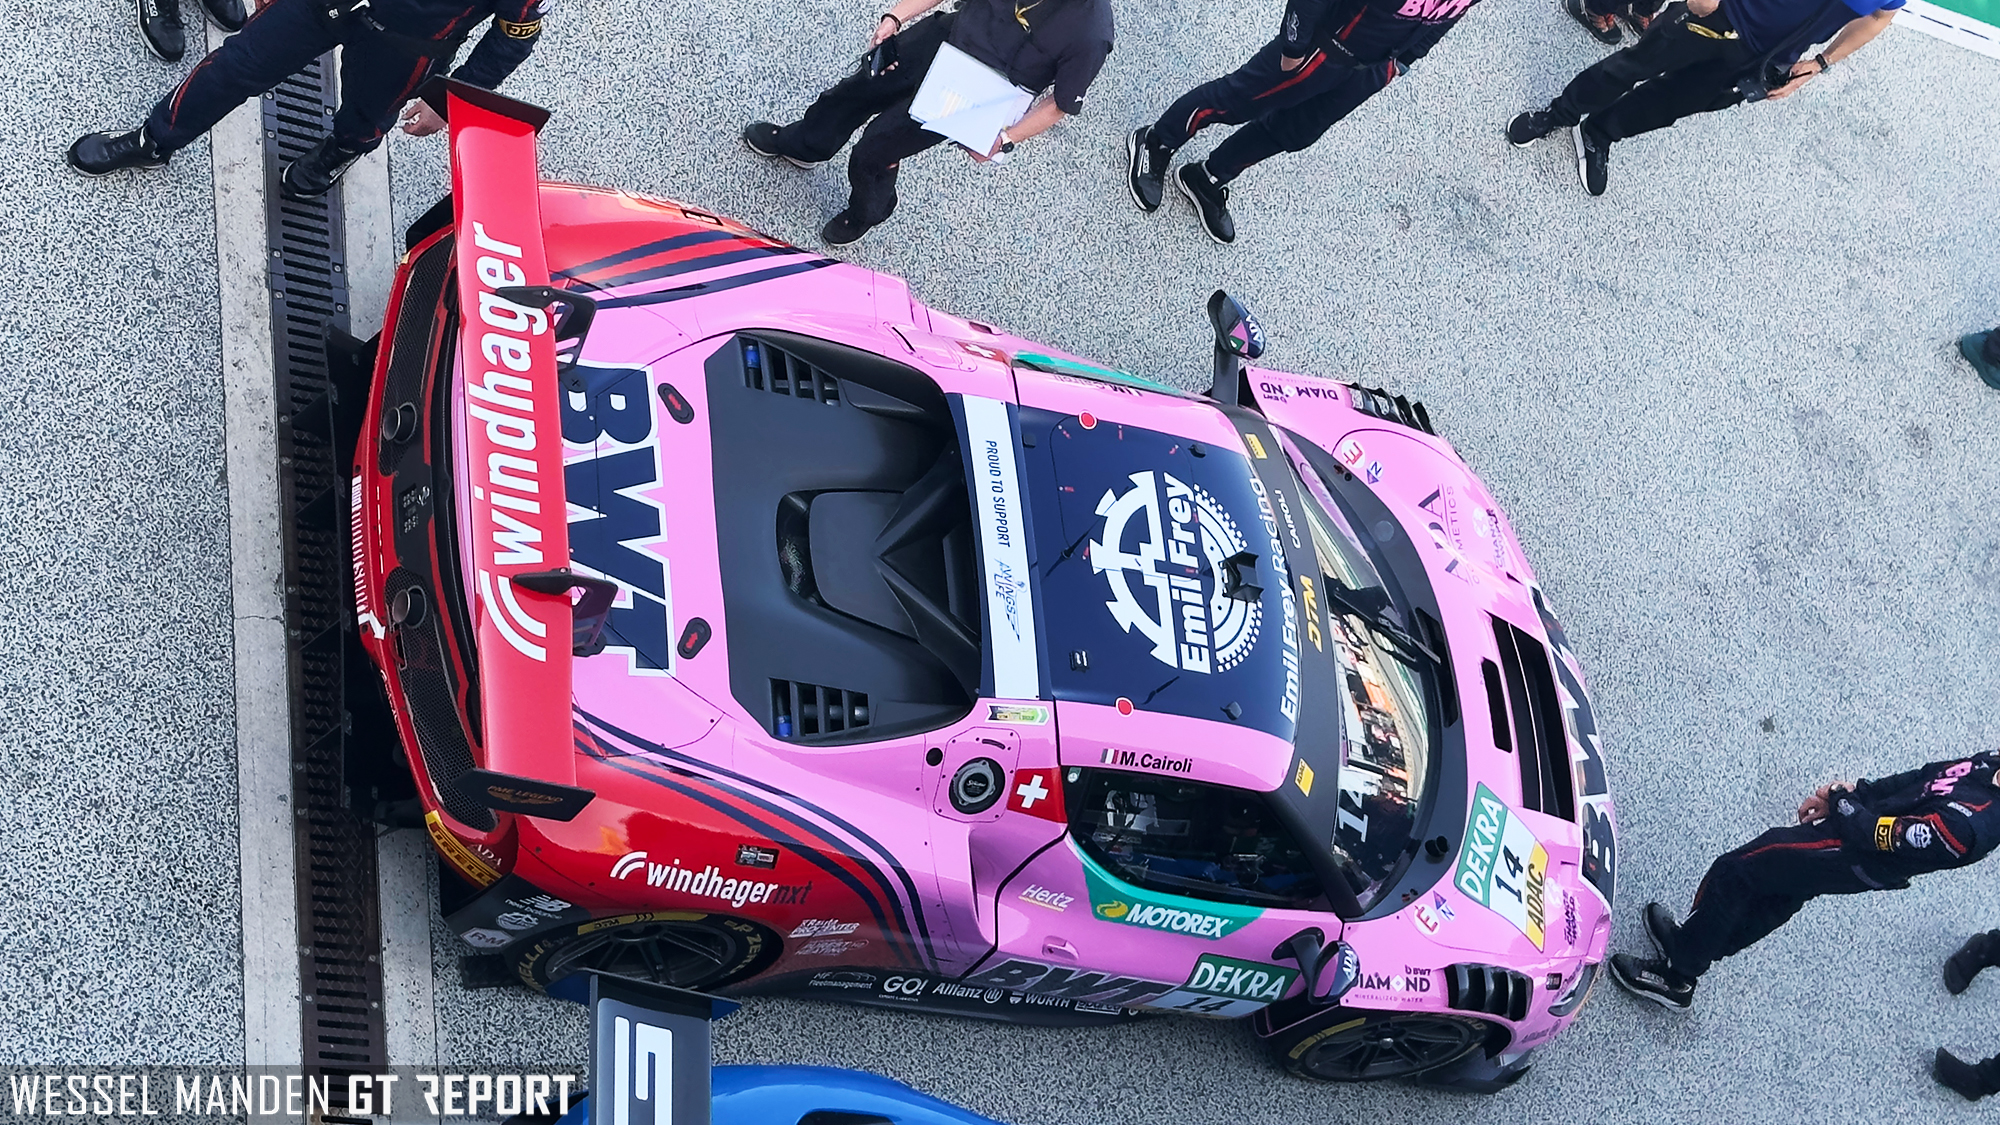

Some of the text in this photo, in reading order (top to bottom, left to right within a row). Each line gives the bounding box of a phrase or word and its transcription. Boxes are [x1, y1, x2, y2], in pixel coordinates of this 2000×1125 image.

[467, 220, 549, 567] windhager
[558, 360, 677, 677] BWT
[985, 439, 1011, 548] PROUD TO SUPPORT
[1249, 477, 1289, 575] Racing
[1274, 489, 1301, 549] CAIROLI
[1446, 486, 1480, 585] CMETICS
[1163, 472, 1212, 674] Emil Frey
[1278, 578, 1298, 648] Frey
[1300, 574, 1323, 653] DTM
[1280, 649, 1300, 724] Emil
[1119, 751, 1193, 773] M.Cairoli
[1459, 796, 1503, 902] DEKRA
[1494, 845, 1524, 904] 14
[1022, 883, 1075, 908] Hertz
[1124, 903, 1230, 938] MOTOREX
[1526, 863, 1545, 934] ADAC
[883, 975, 929, 996] GO!
[931, 982, 983, 999] Allianz
[1187, 961, 1288, 1001] DEKRA
[1358, 972, 1431, 993] IAMOND
